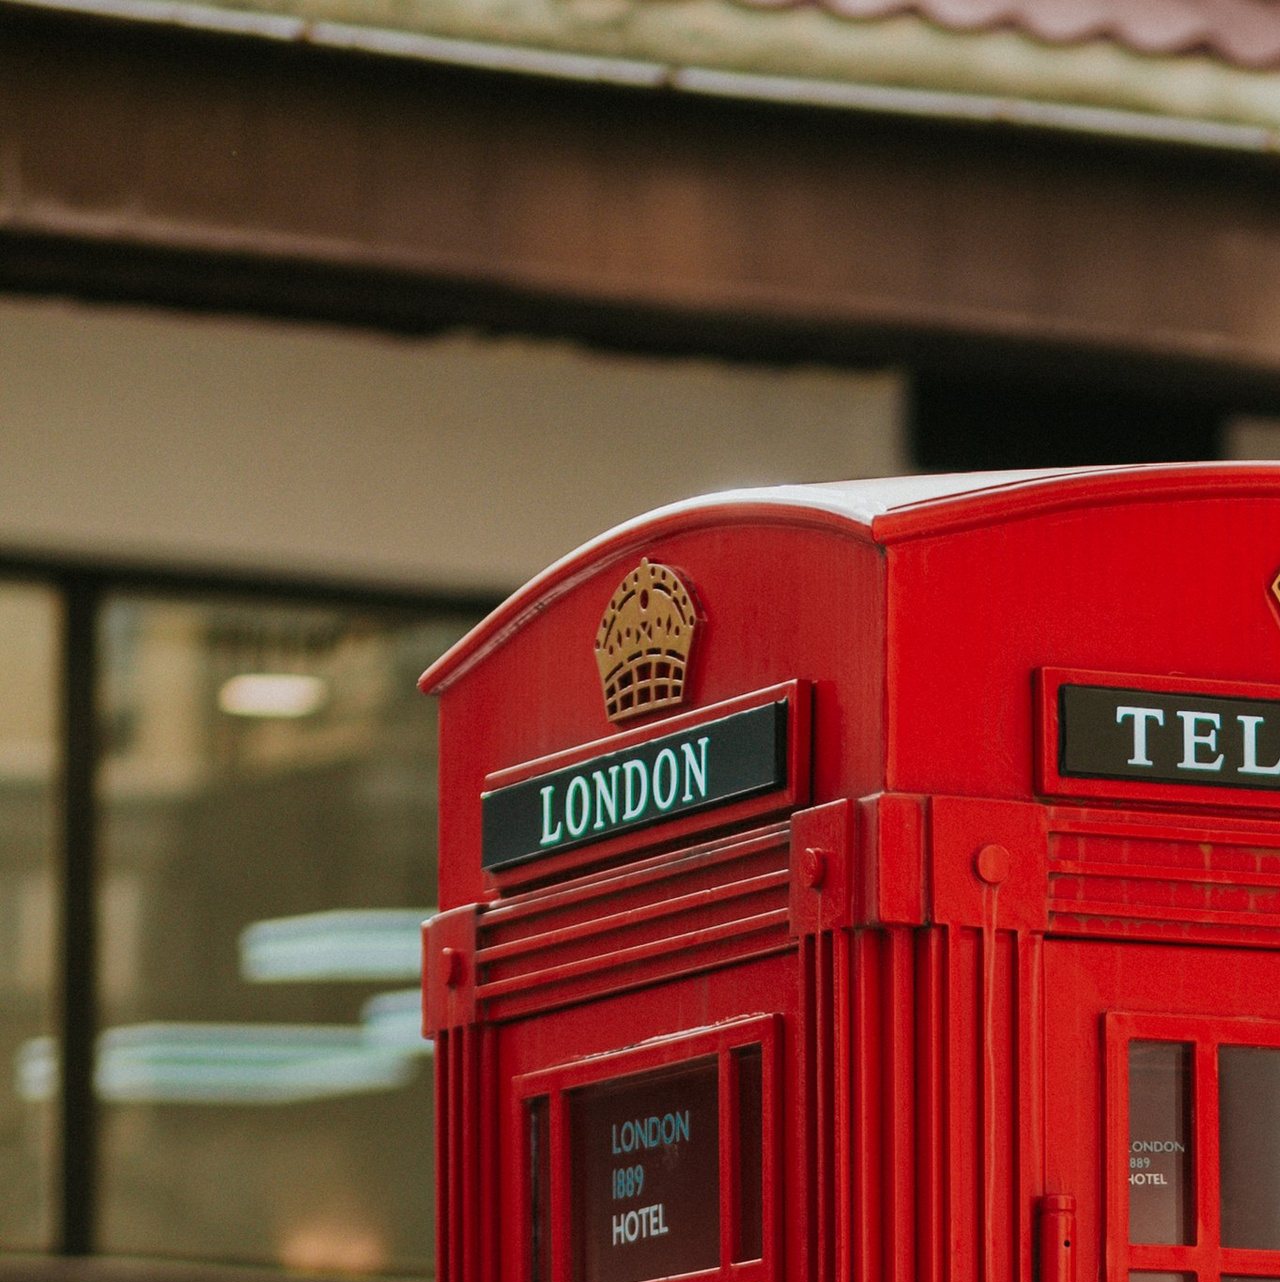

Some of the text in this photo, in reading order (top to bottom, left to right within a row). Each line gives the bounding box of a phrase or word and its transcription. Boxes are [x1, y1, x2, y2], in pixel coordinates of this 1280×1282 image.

[539, 736, 710, 846] LONDON
[611, 1110, 690, 1155] LONDON
[1128, 1141, 1185, 1152] ONDON
[612, 1164, 645, 1200] 1889
[1129, 1157, 1150, 1169] 889
[612, 1203, 669, 1246] HOTEL
